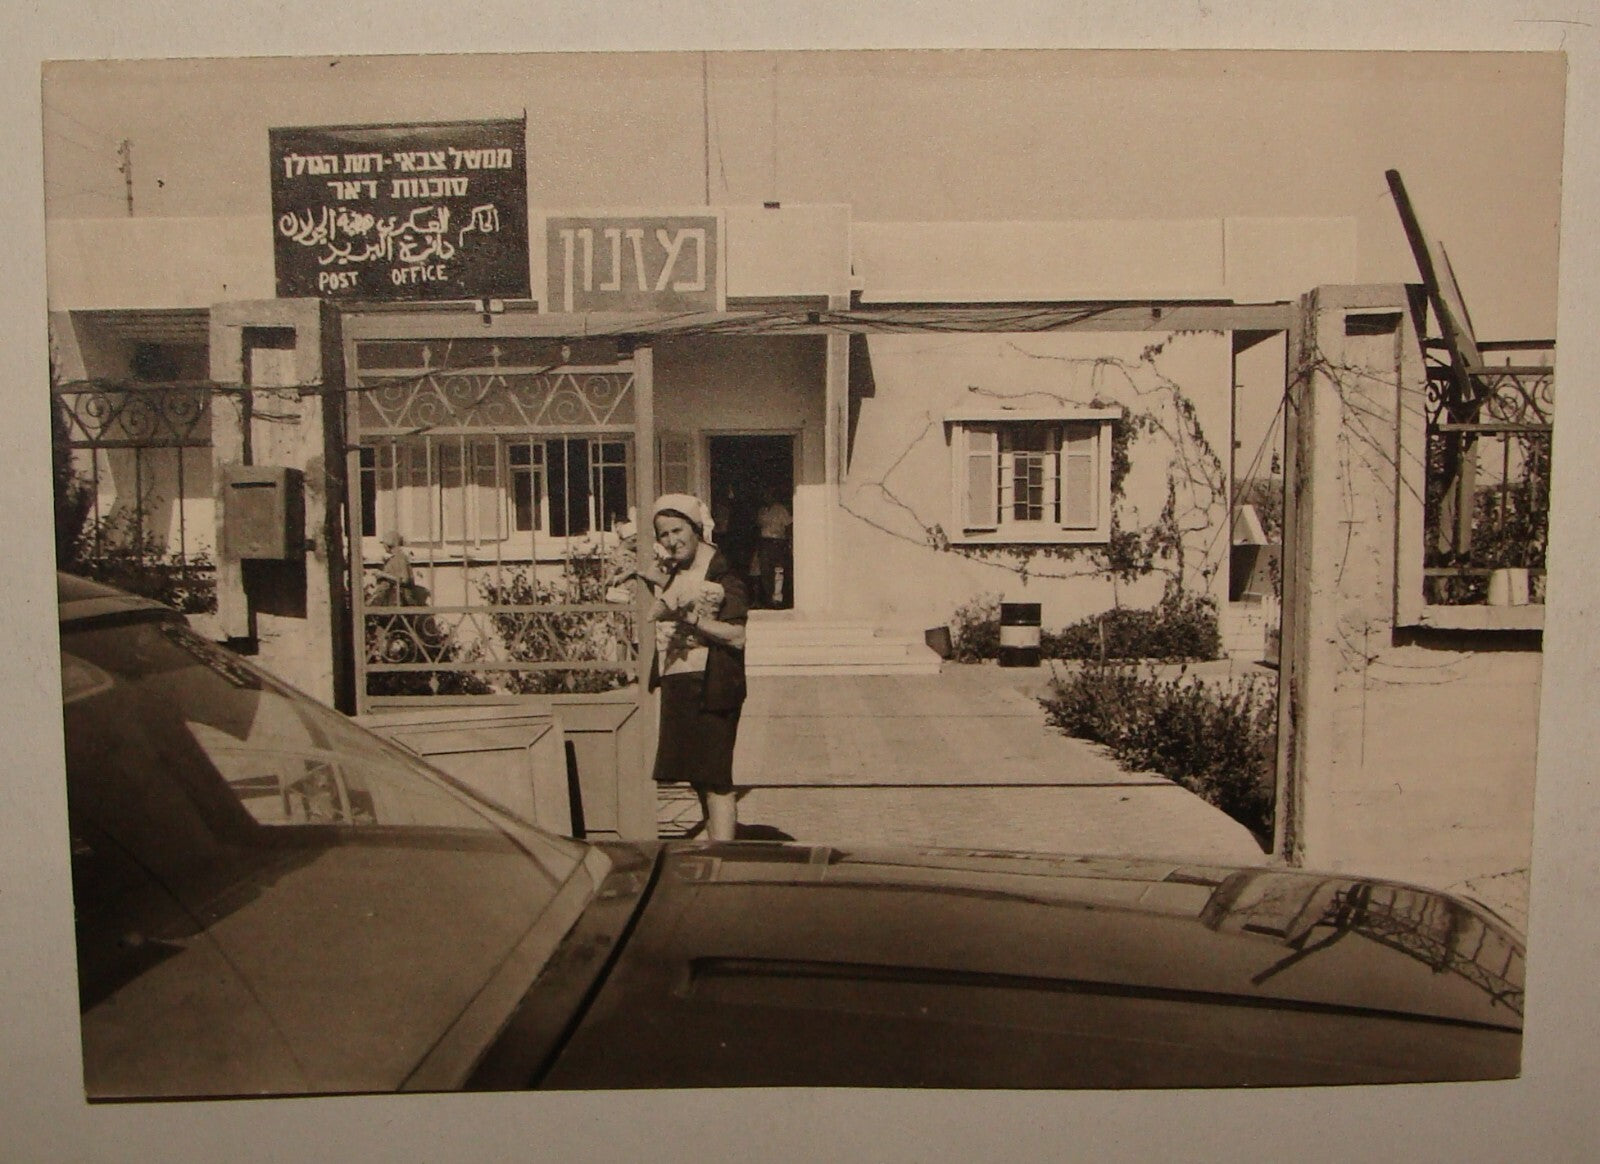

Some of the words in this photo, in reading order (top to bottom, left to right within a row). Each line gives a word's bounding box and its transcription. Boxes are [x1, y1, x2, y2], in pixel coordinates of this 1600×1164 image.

[447, 147, 513, 170] ממשל
[327, 179, 379, 200] דאר
[391, 177, 469, 199] סוכנות
[317, 234, 394, 265] البريد
[318, 271, 360, 292] POST
[390, 263, 449, 286] OFFICE
[559, 228, 706, 313] מזנון
